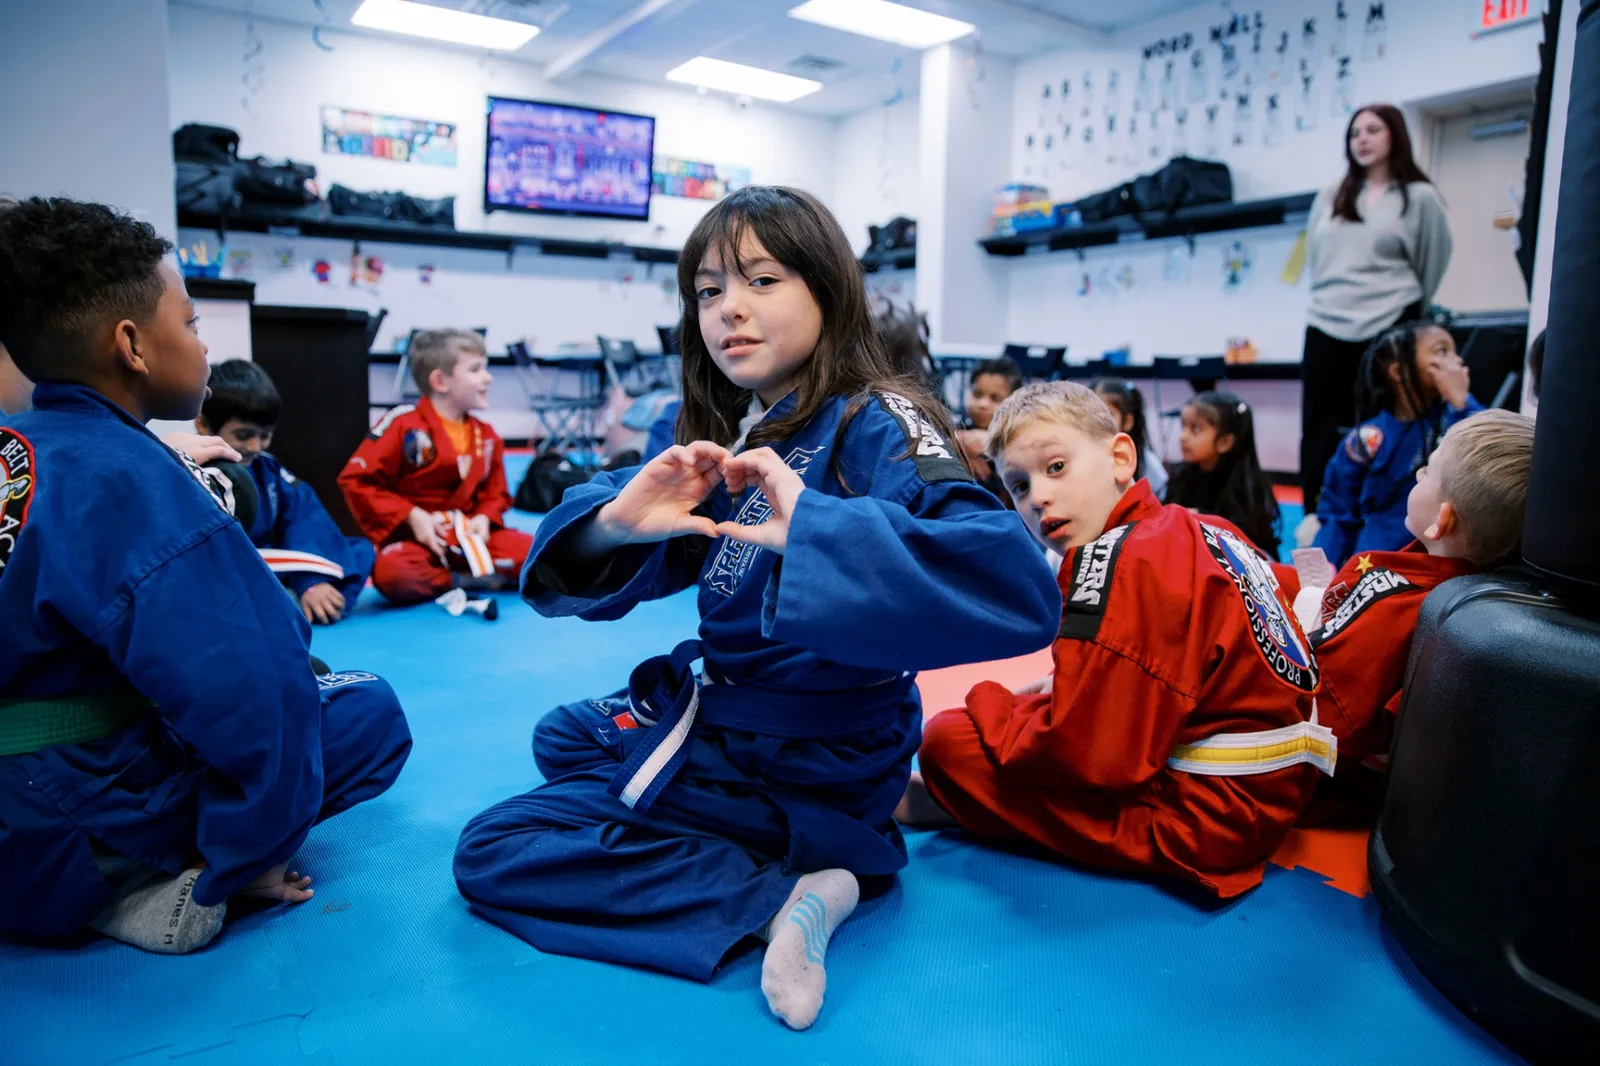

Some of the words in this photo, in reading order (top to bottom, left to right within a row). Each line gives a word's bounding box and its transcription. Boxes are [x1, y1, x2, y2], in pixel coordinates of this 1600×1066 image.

[0, 438, 29, 475] BELT
[1217, 556, 1301, 685] PROFESSIONAL
[1321, 570, 1411, 640] MASTERS
[169, 876, 197, 928] Hanes
